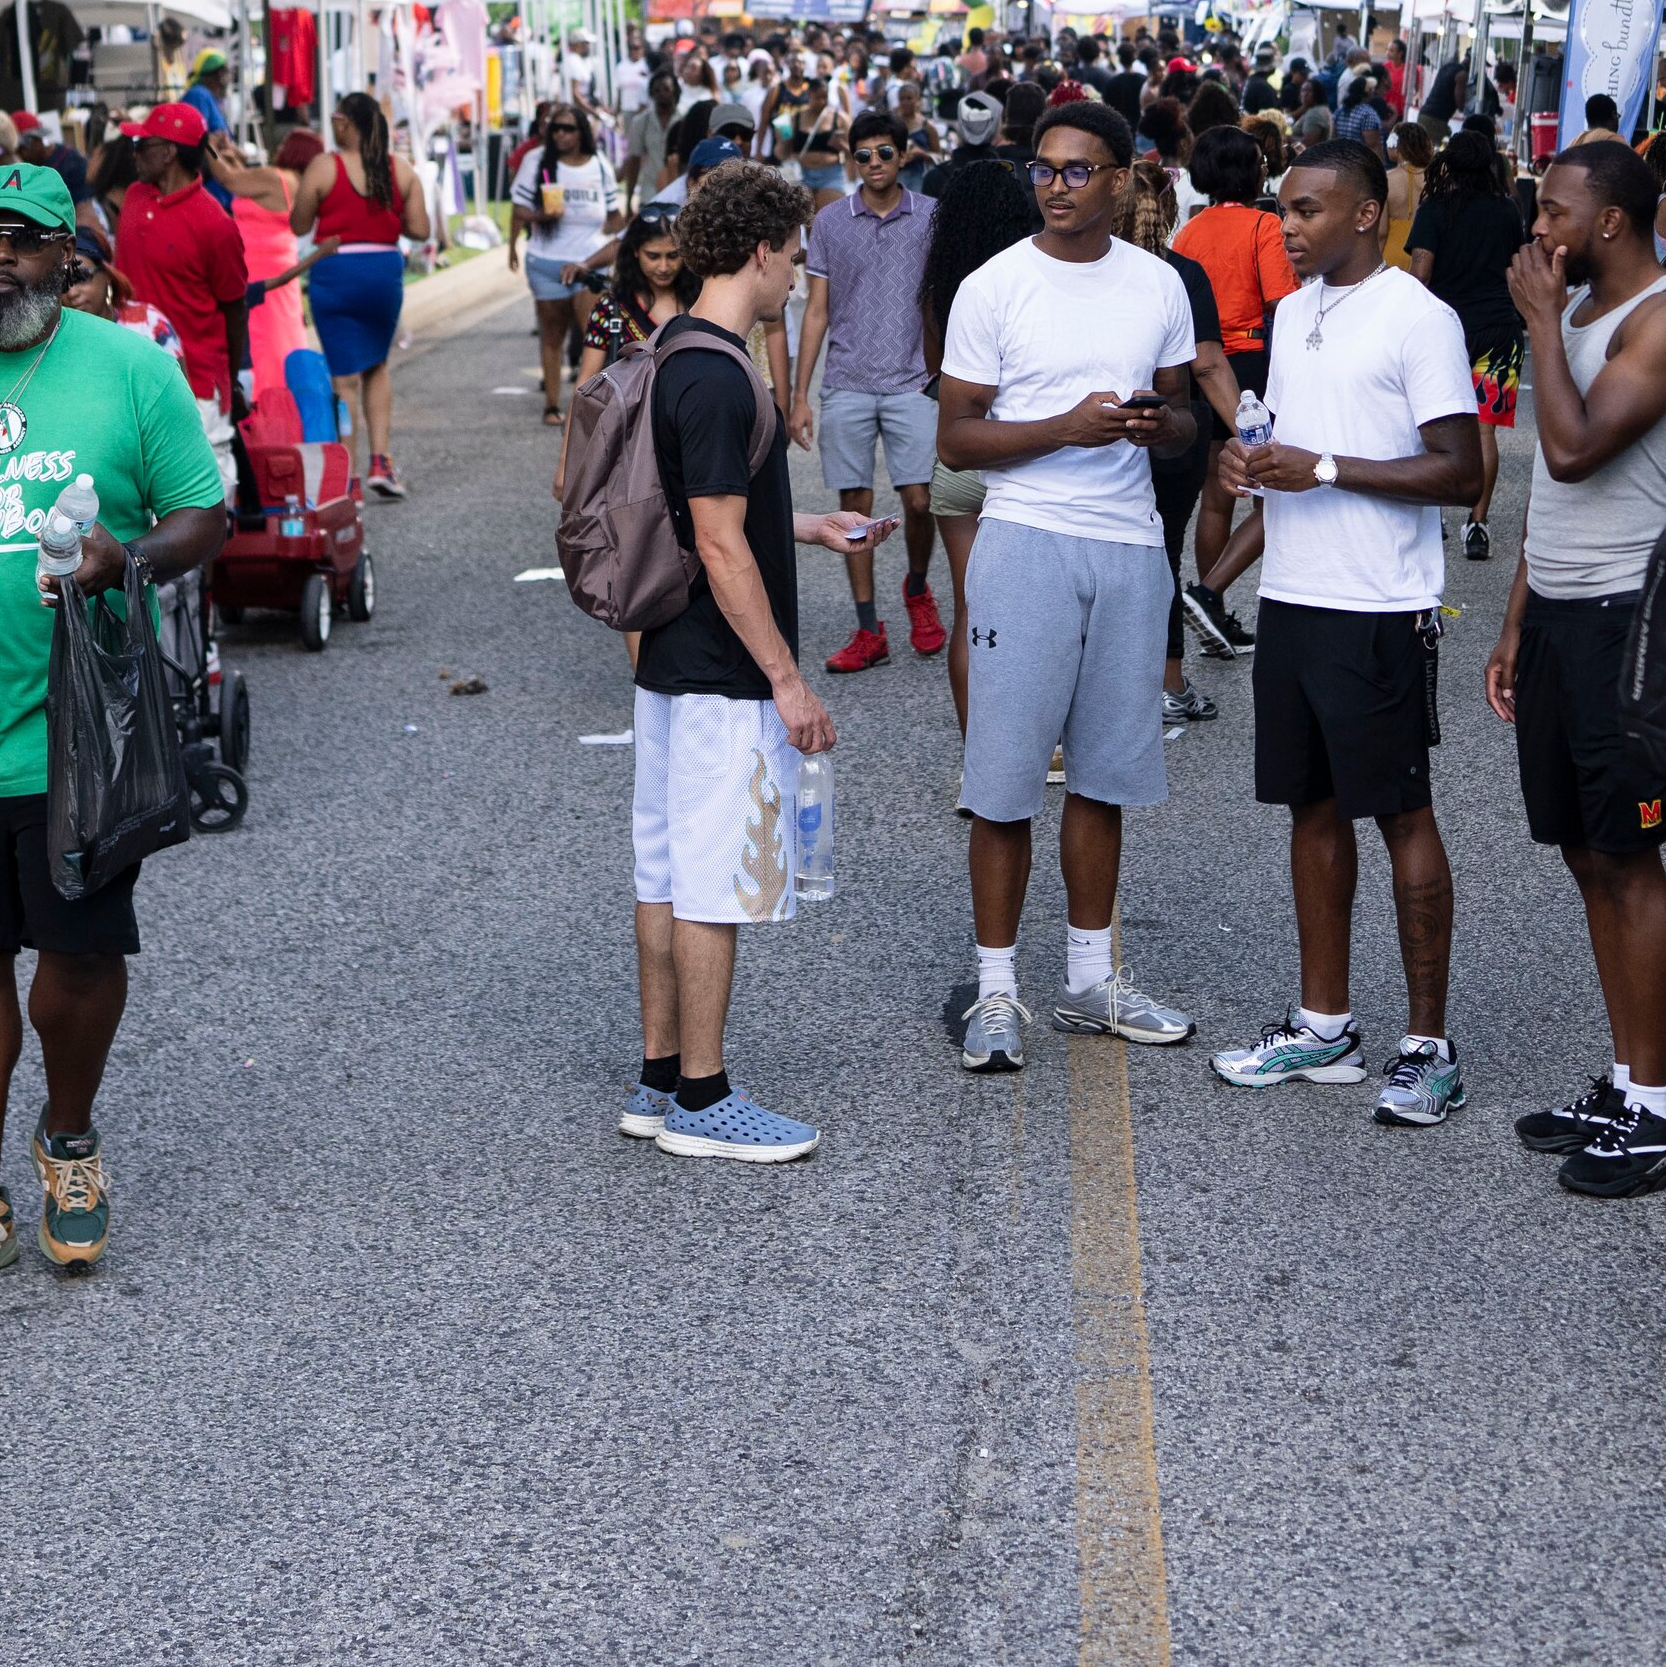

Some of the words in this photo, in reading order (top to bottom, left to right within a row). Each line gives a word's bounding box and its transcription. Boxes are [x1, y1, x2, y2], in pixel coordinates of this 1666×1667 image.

[1606, 54, 1622, 100] HING
[0, 169, 23, 192] A
[1631, 621, 1652, 702] ARMOUR
[1425, 659, 1438, 740] lululemon
[1638, 798, 1662, 829] M
